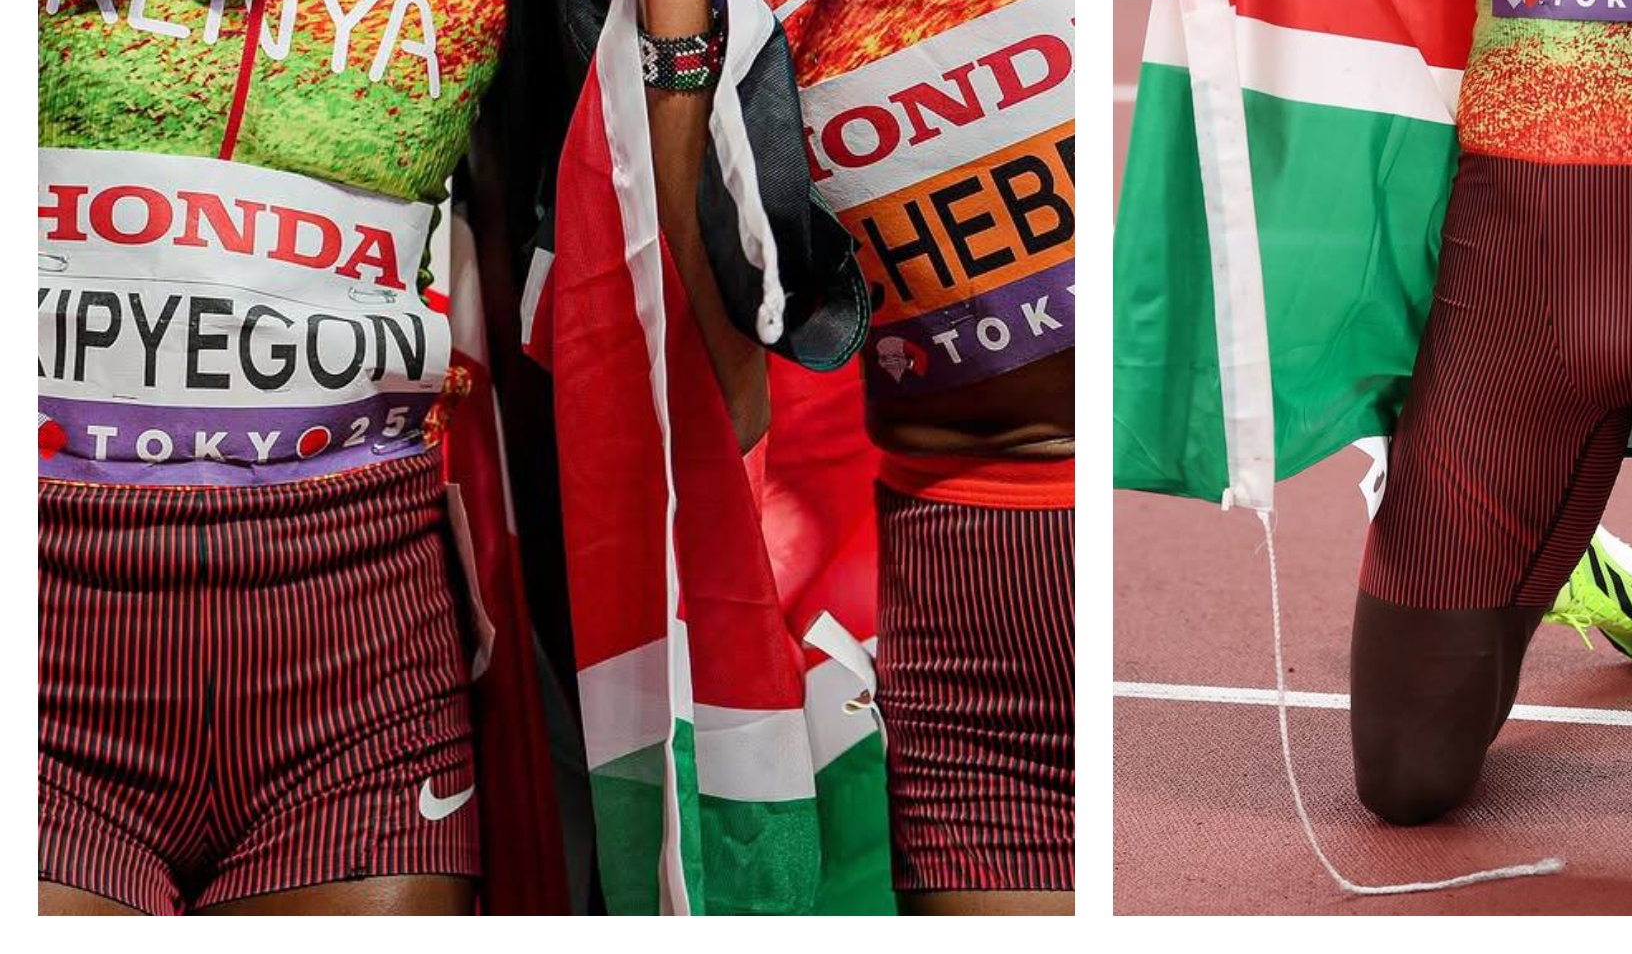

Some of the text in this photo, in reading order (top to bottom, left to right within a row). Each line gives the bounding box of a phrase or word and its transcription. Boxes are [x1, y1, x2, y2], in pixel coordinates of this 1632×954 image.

[803, 18, 1075, 182] OND
[871, 135, 1075, 314] HEB
[932, 285, 1075, 364] TOK
[343, 407, 411, 448] 25
